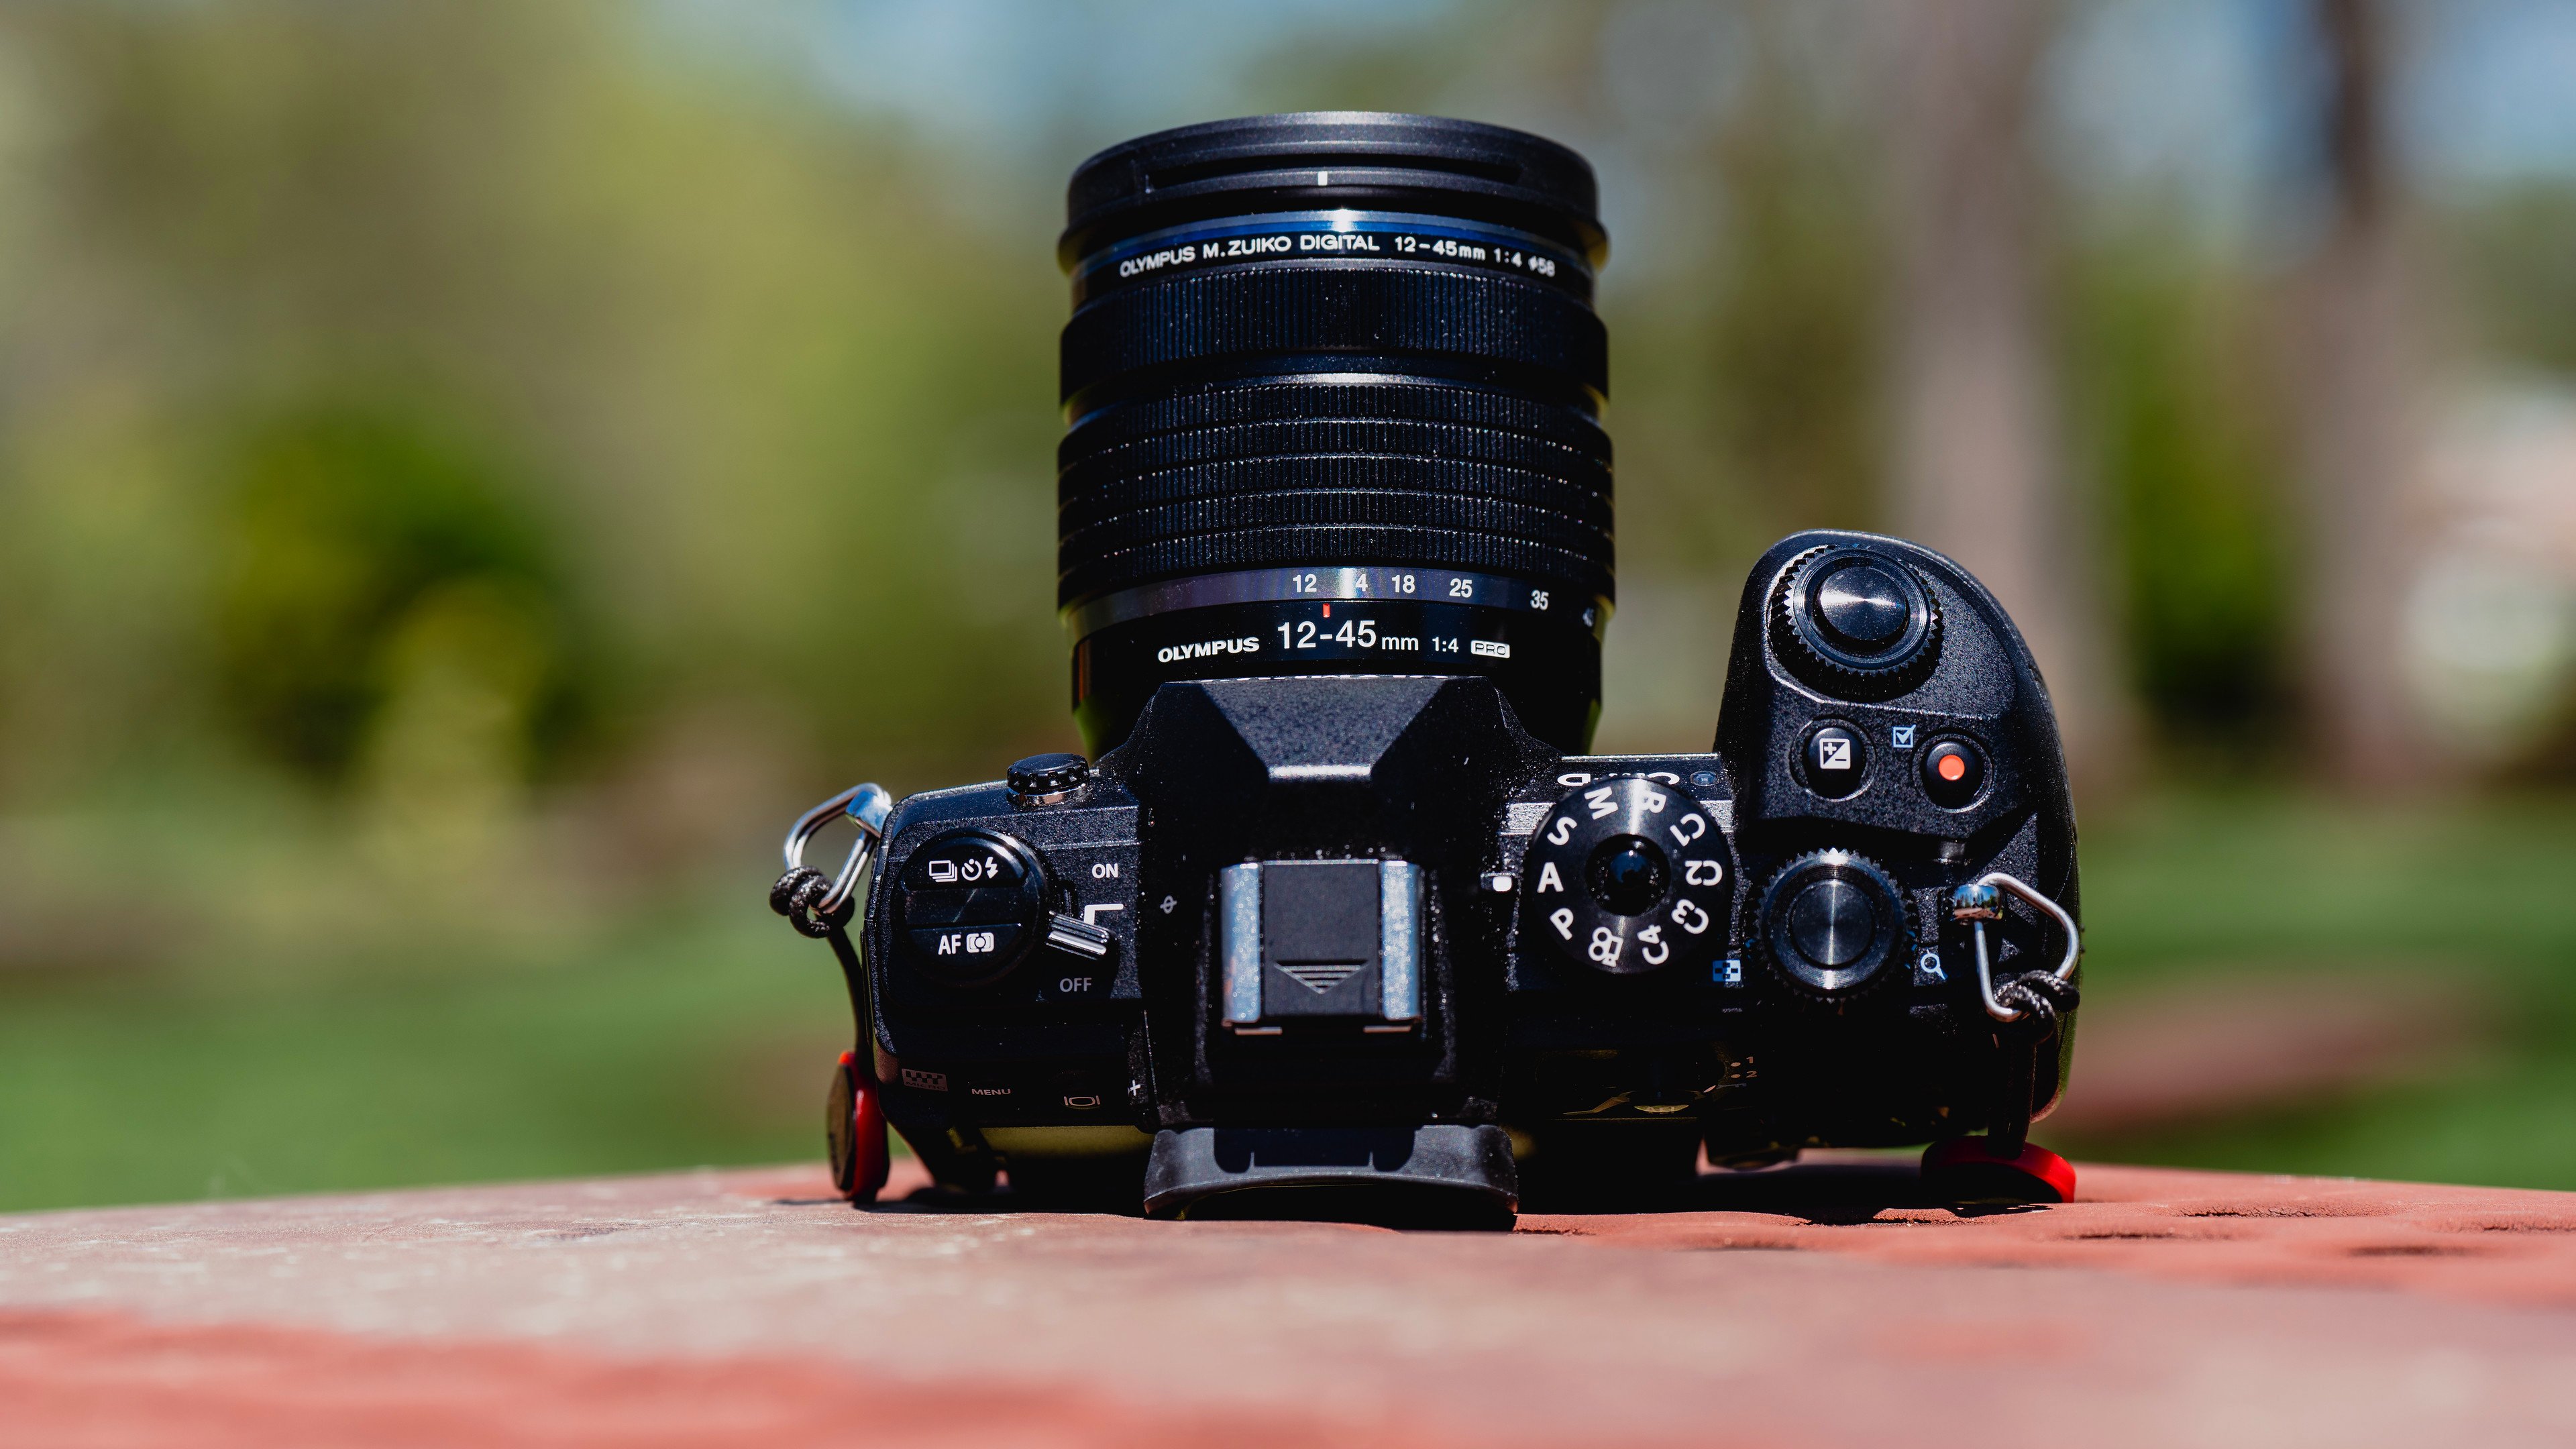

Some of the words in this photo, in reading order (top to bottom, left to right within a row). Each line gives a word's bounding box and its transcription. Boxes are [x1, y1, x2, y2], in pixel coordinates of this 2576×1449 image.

[1120, 245, 1197, 278] OLYMPUS
[1202, 235, 1292, 259] M.ZUIKO
[1299, 234, 1381, 252] DIGITAL
[1395, 235, 1487, 262] 12-45mm
[1493, 247, 1523, 268] 1:4
[1292, 573, 1318, 593] 12
[1391, 574, 1416, 594] 18
[1449, 578, 1473, 598] 25
[1529, 590, 1550, 610] 35
[1157, 636, 1260, 663] OLYMPUS
[1277, 619, 1377, 649] 12-45
[1381, 636, 1419, 651] mm
[1431, 635, 1460, 653] 1:4
[1474, 642, 1507, 656] PRO
[1584, 786, 1619, 820] M
[1642, 788, 1667, 814] B
[1546, 816, 1578, 846] S
[1669, 812, 1706, 847] C1
[1091, 862, 1119, 879] ON
[1536, 861, 1564, 894] A
[1684, 859, 1723, 887] C2
[1549, 908, 1574, 941] P
[1671, 899, 1709, 934] C3
[937, 933, 962, 956] AF
[1637, 924, 1670, 965] C4
[1059, 977, 1093, 993] OFF
[1746, 1055, 1754, 1065] 1
[1746, 1070, 1758, 1079] 2
[971, 1087, 1012, 1096] MENU
